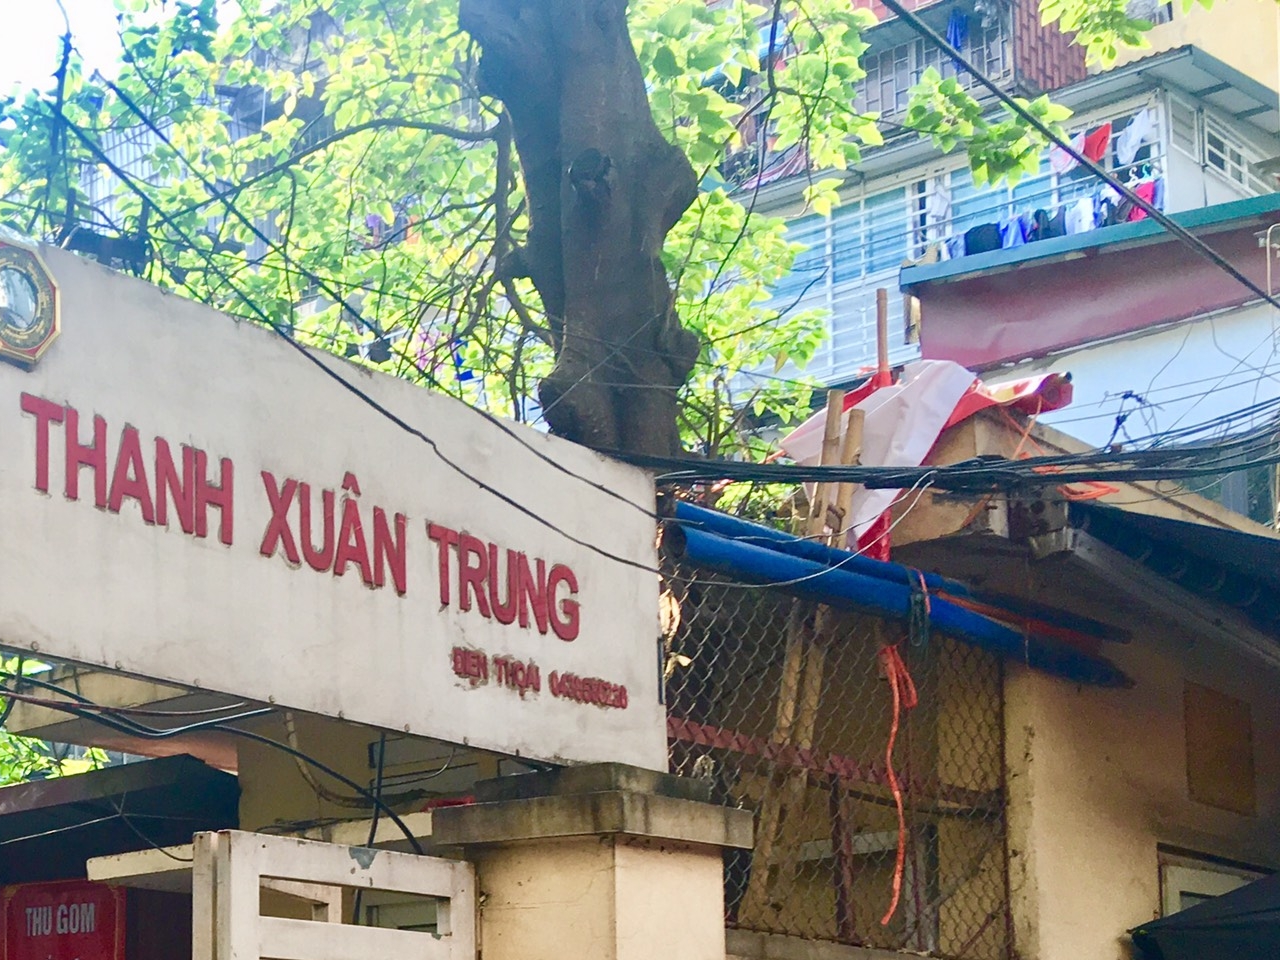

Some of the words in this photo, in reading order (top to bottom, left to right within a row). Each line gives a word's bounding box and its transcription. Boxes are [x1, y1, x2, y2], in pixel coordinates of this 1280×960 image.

[20, 392, 234, 546] THANH
[260, 471, 407, 597] XUÂN
[427, 523, 580, 642] TRUNG
[25, 906, 53, 937] THU
[56, 902, 96, 935] GOM
